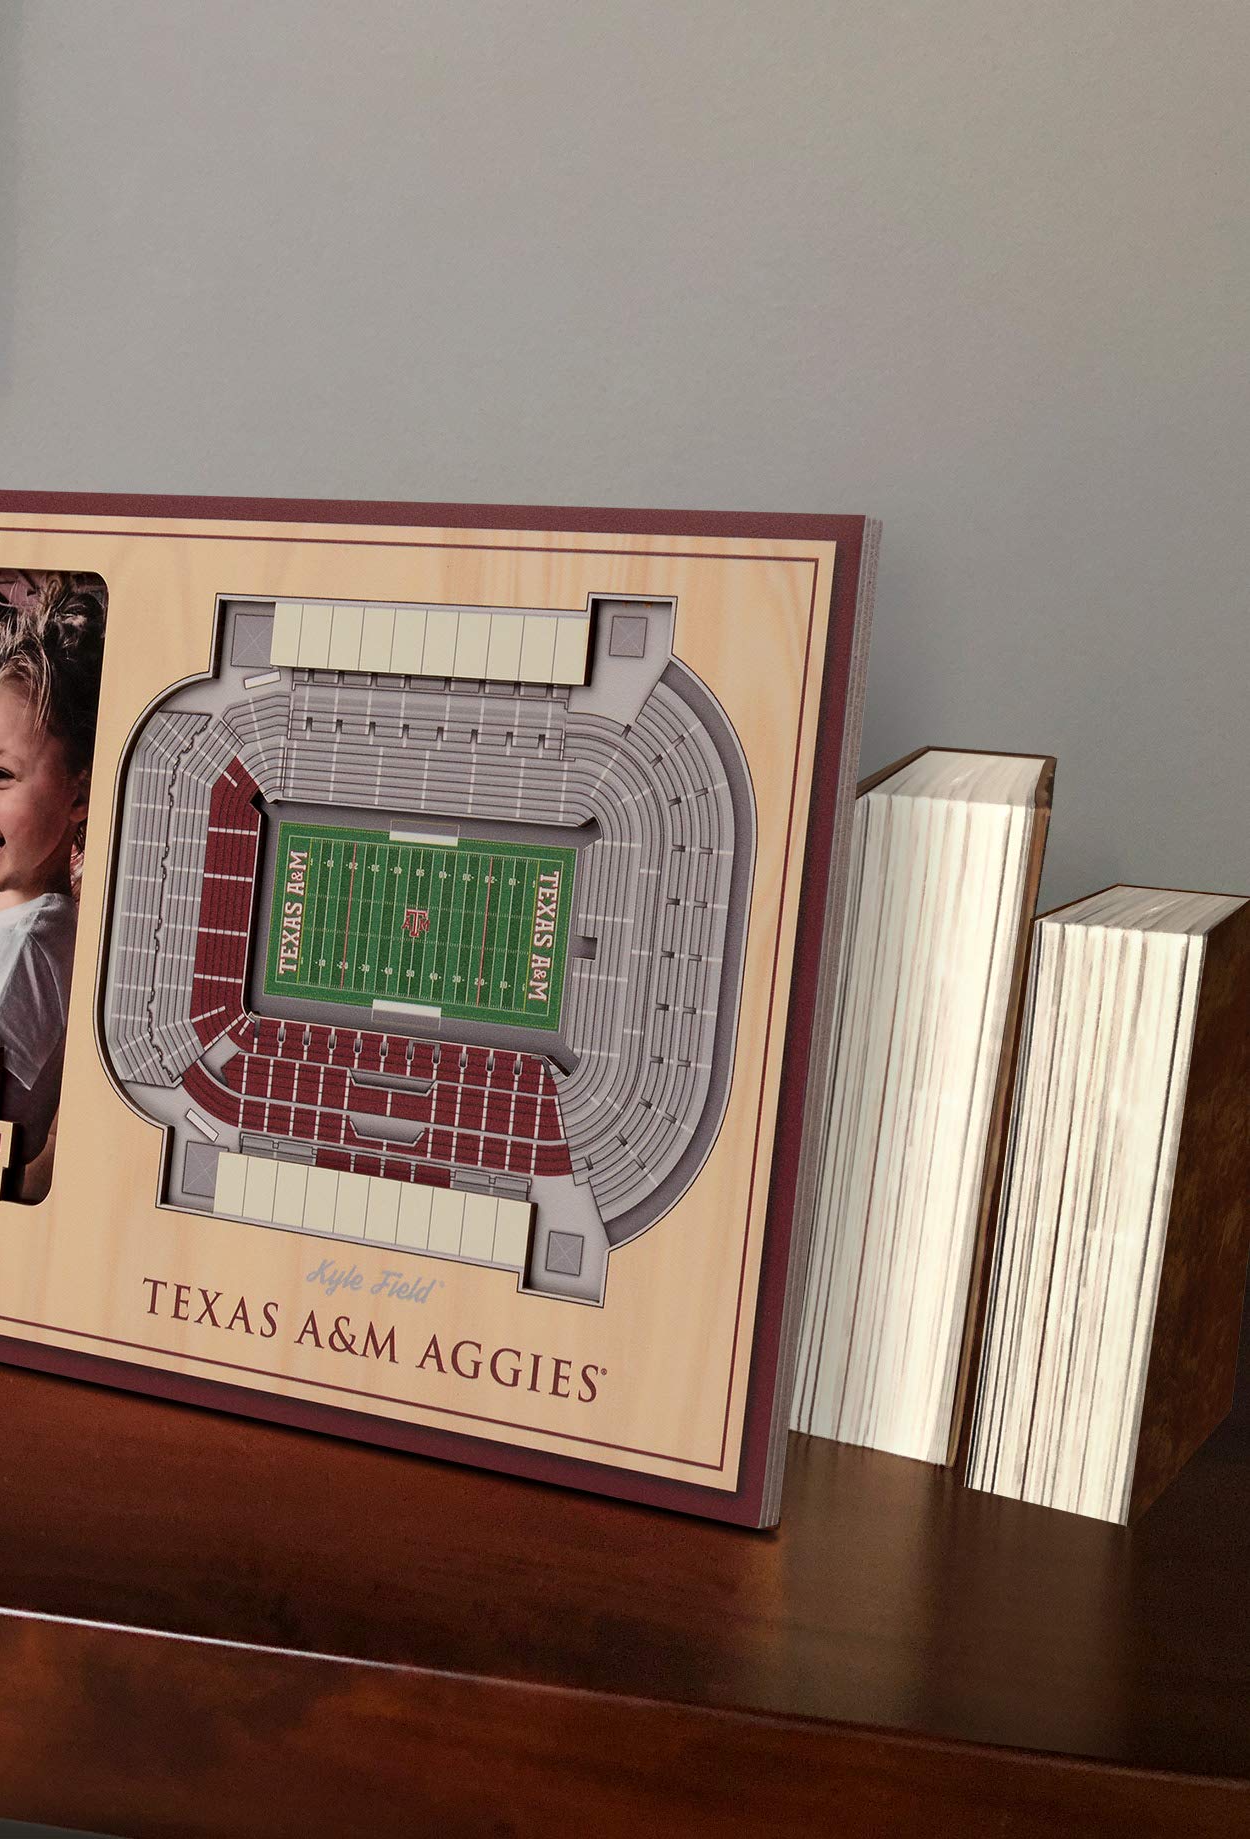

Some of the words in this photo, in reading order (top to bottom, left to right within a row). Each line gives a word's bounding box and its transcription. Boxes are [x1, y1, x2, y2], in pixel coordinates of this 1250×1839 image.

[286, 850, 308, 896] A&M
[278, 901, 303, 975] TEXAS
[534, 869, 561, 949] TEXAS
[528, 953, 552, 1002] A&M
[306, 1258, 364, 1297] Kyle
[370, 1269, 437, 1304] Field
[142, 1277, 280, 1339] TEXAS
[293, 1310, 400, 1364] A&M
